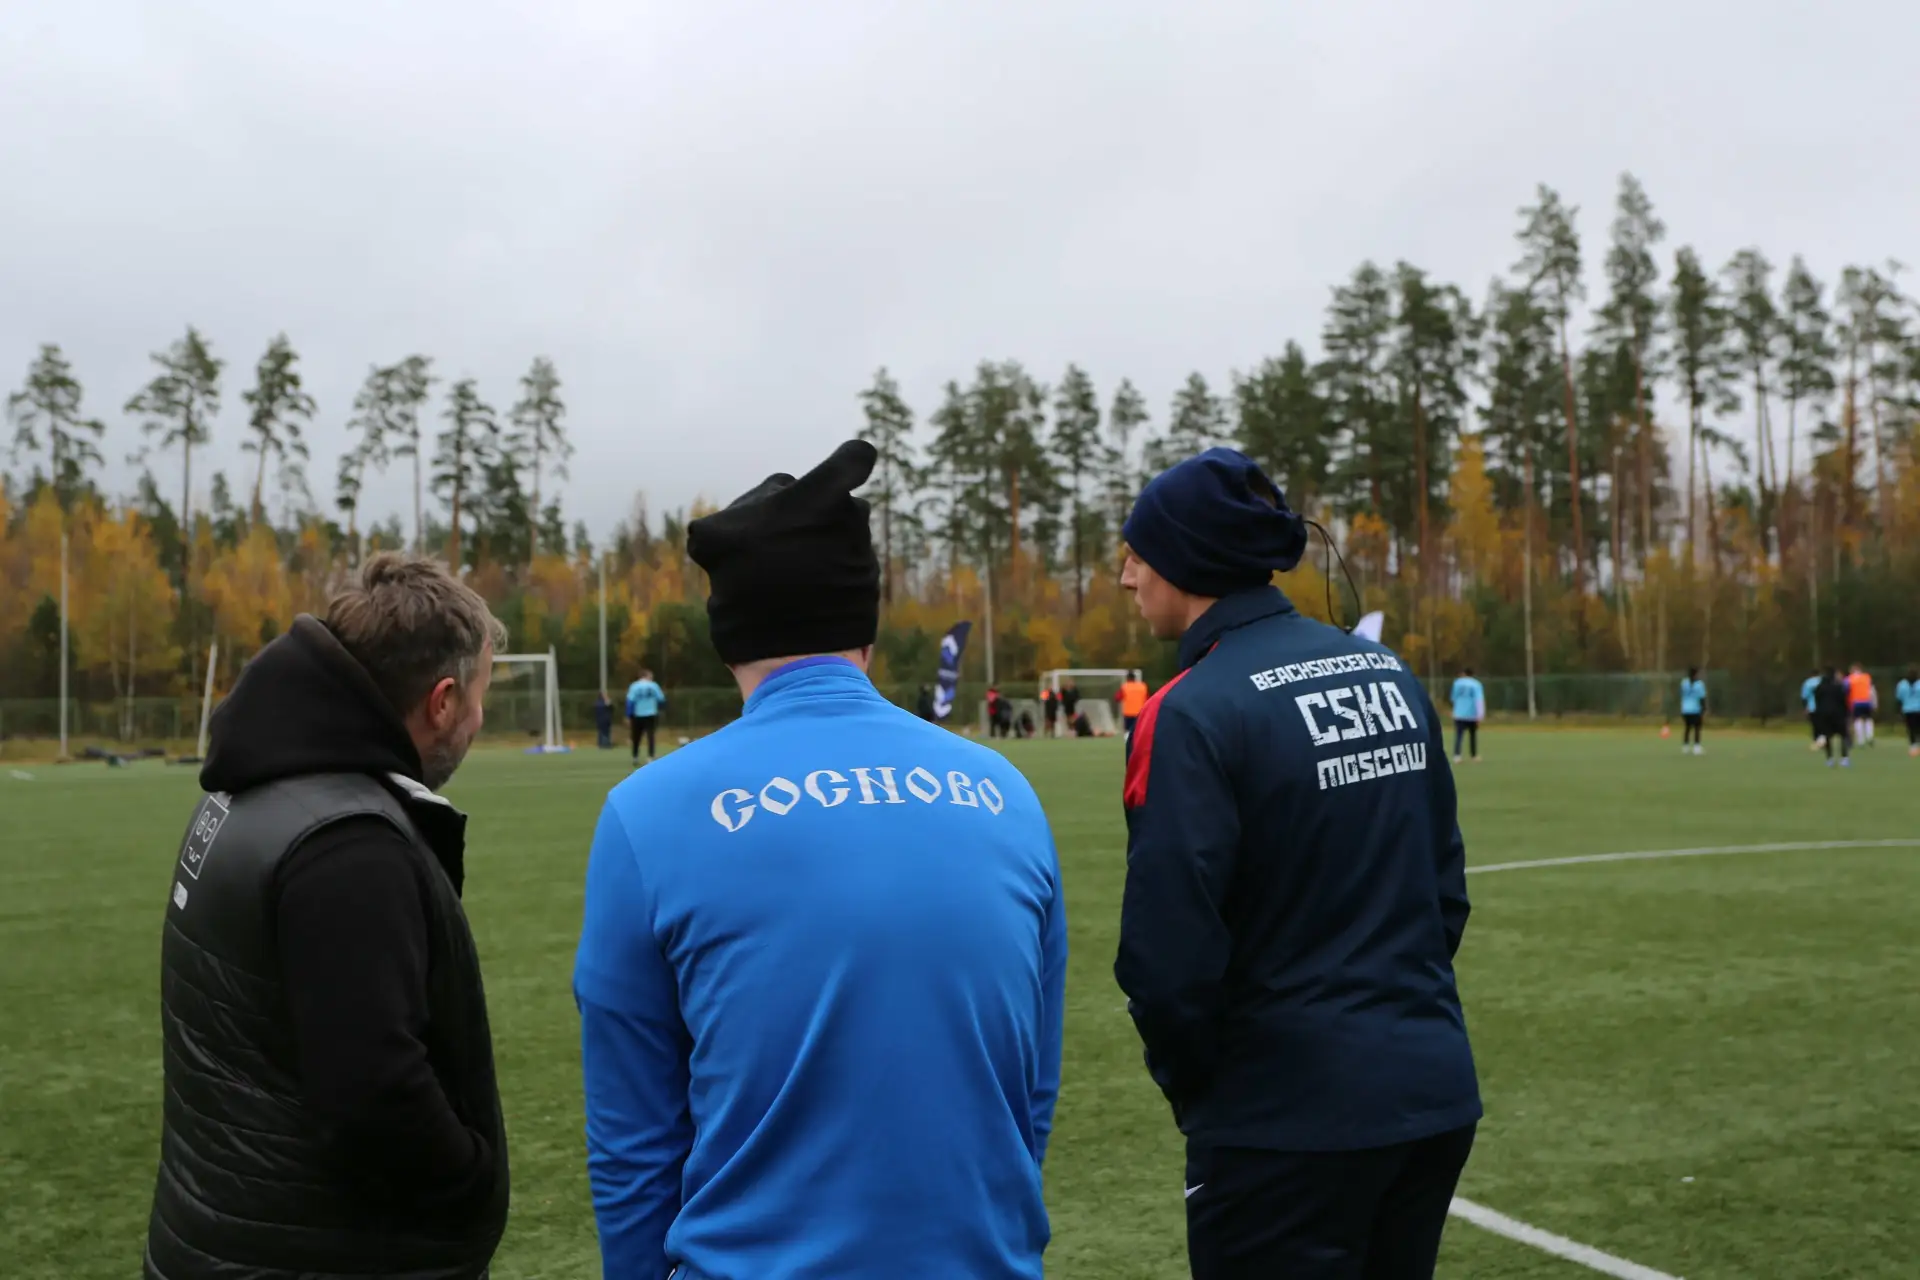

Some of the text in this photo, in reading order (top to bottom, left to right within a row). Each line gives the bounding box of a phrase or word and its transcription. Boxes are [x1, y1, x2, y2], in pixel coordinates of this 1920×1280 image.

[1250, 654, 1370, 691] BEACHSOCCER
[1295, 682, 1418, 746] CSKA
[1317, 742, 1427, 790] MOSCOW
